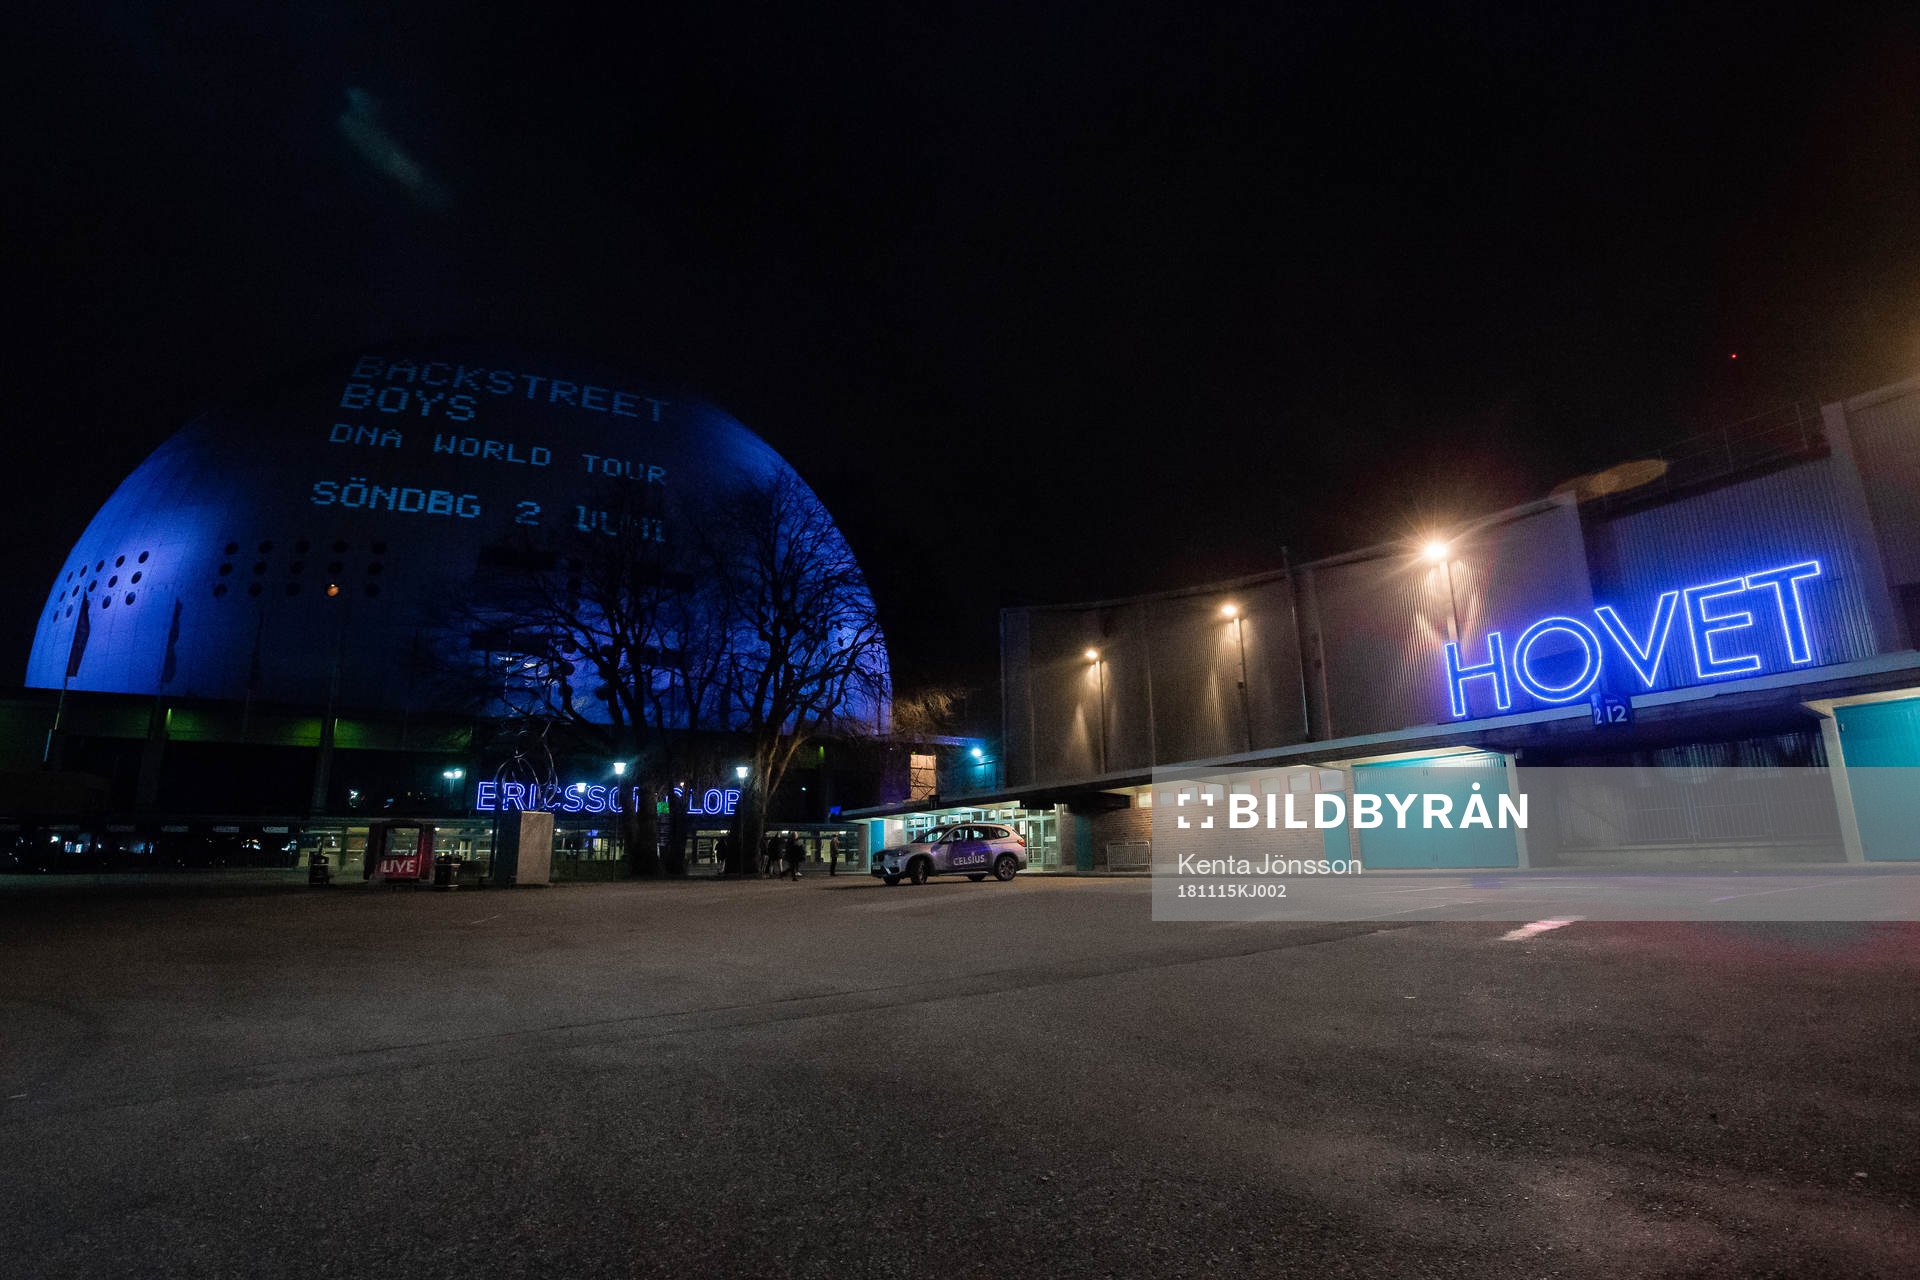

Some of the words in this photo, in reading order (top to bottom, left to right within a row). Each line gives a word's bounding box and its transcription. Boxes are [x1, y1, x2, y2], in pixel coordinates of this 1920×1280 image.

[340, 382, 478, 421] BOYS
[351, 356, 669, 422] BACKSTREET
[329, 423, 403, 448] DNA
[433, 434, 552, 466] WORLD
[582, 454, 668, 485] TOUR
[515, 500, 541, 526] 2
[1443, 560, 1821, 717] HOVET
[1606, 705, 1628, 723] 12
[383, 859, 415, 873] LIVE
[953, 851, 985, 866] CELSIUS
